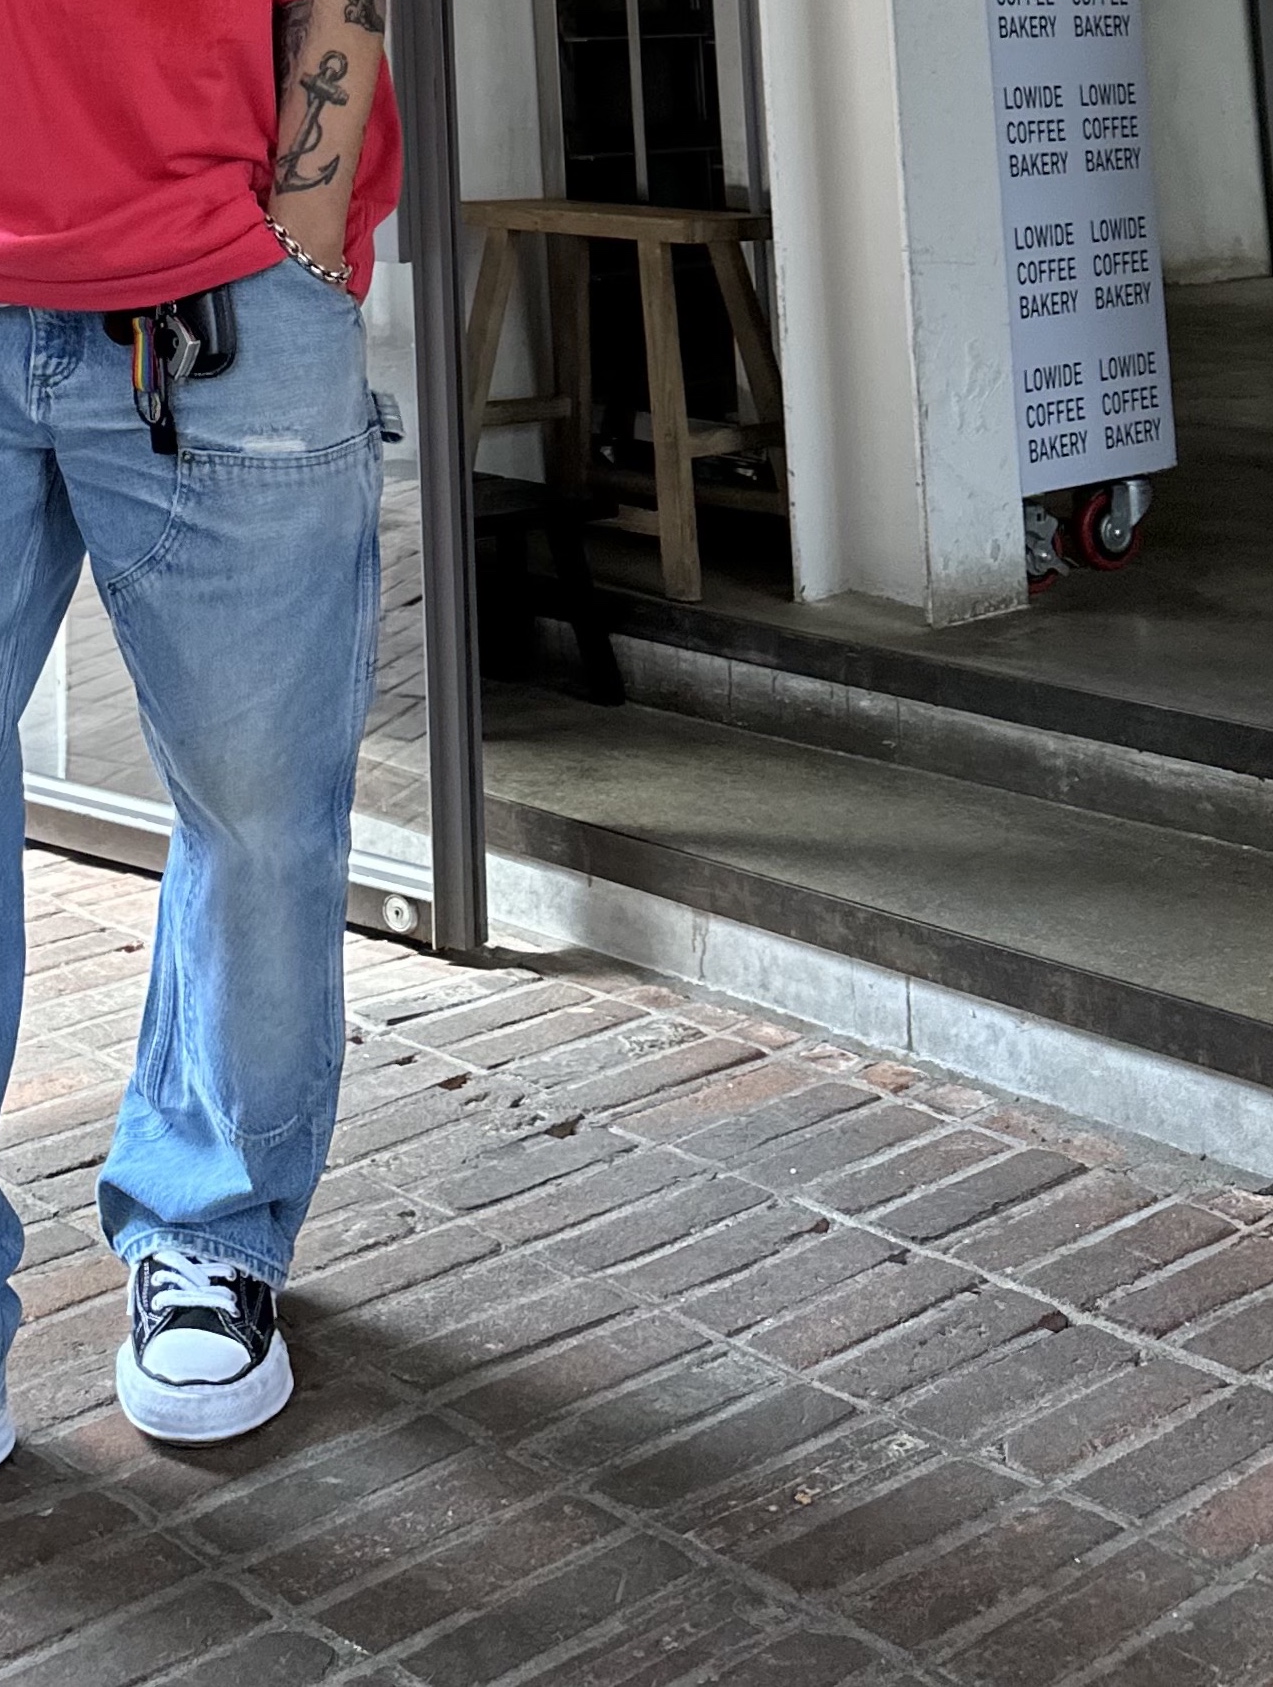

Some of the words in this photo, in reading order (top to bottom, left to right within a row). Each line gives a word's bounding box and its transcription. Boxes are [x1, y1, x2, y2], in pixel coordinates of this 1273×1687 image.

[997, 14, 1057, 39] BAKERY
[1073, 14, 1130, 38] BAKERY
[1002, 84, 1064, 111] LOWIDE
[1078, 82, 1137, 107] LOWIDE
[1005, 118, 1067, 145] COFFEE
[1081, 114, 1139, 141] COFFEE
[1008, 150, 1069, 178] BAKERY
[1084, 147, 1141, 173] BAKERY
[1013, 221, 1075, 251] LOWIDE
[1089, 215, 1148, 244] LOWIDE
[1016, 256, 1078, 286] COFFEE
[1092, 248, 1150, 278] COFFEE
[1018, 289, 1079, 320] BAKERY
[1094, 281, 1152, 311] BAKERY
[1023, 361, 1084, 394] LOWIDE
[1098, 351, 1157, 382] LOWIDE
[1025, 396, 1087, 430] COFFEE
[1101, 384, 1160, 417] COFFEE
[1027, 429, 1088, 463] BAKERY
[1104, 417, 1161, 450] BAKERY
